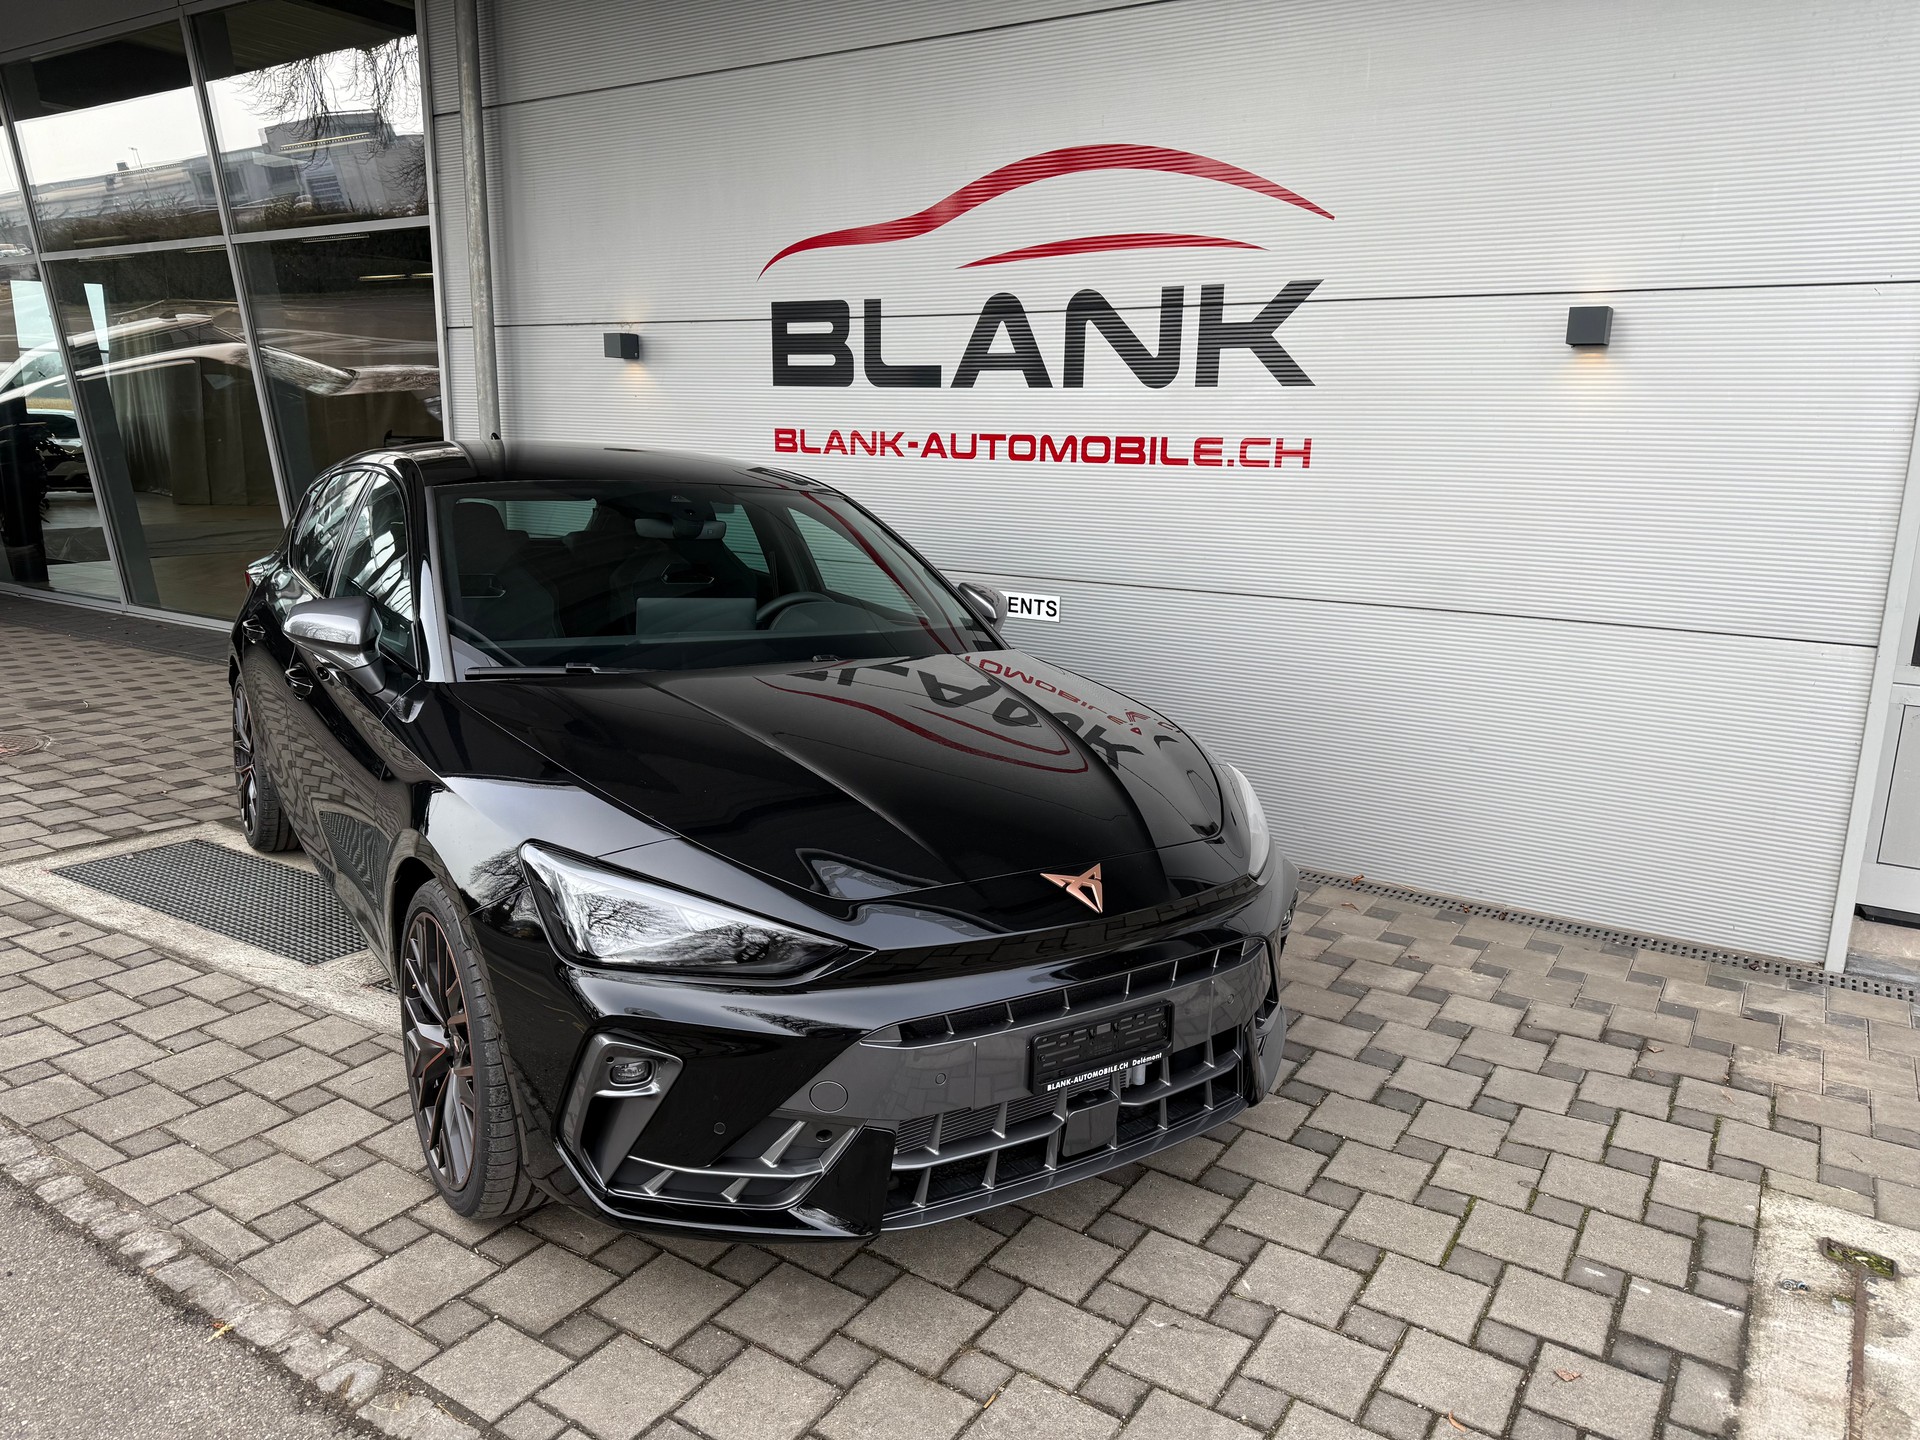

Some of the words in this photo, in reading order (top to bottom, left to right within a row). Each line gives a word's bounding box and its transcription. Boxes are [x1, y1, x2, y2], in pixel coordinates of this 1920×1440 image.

[771, 279, 1323, 388] BLANK
[774, 428, 1312, 469] BLANK-AUTOMOBILE.CH
[1047, 1061, 1129, 1091] BLANK-AUTOMOBILE.CH
[1132, 1052, 1163, 1067] Delémont
